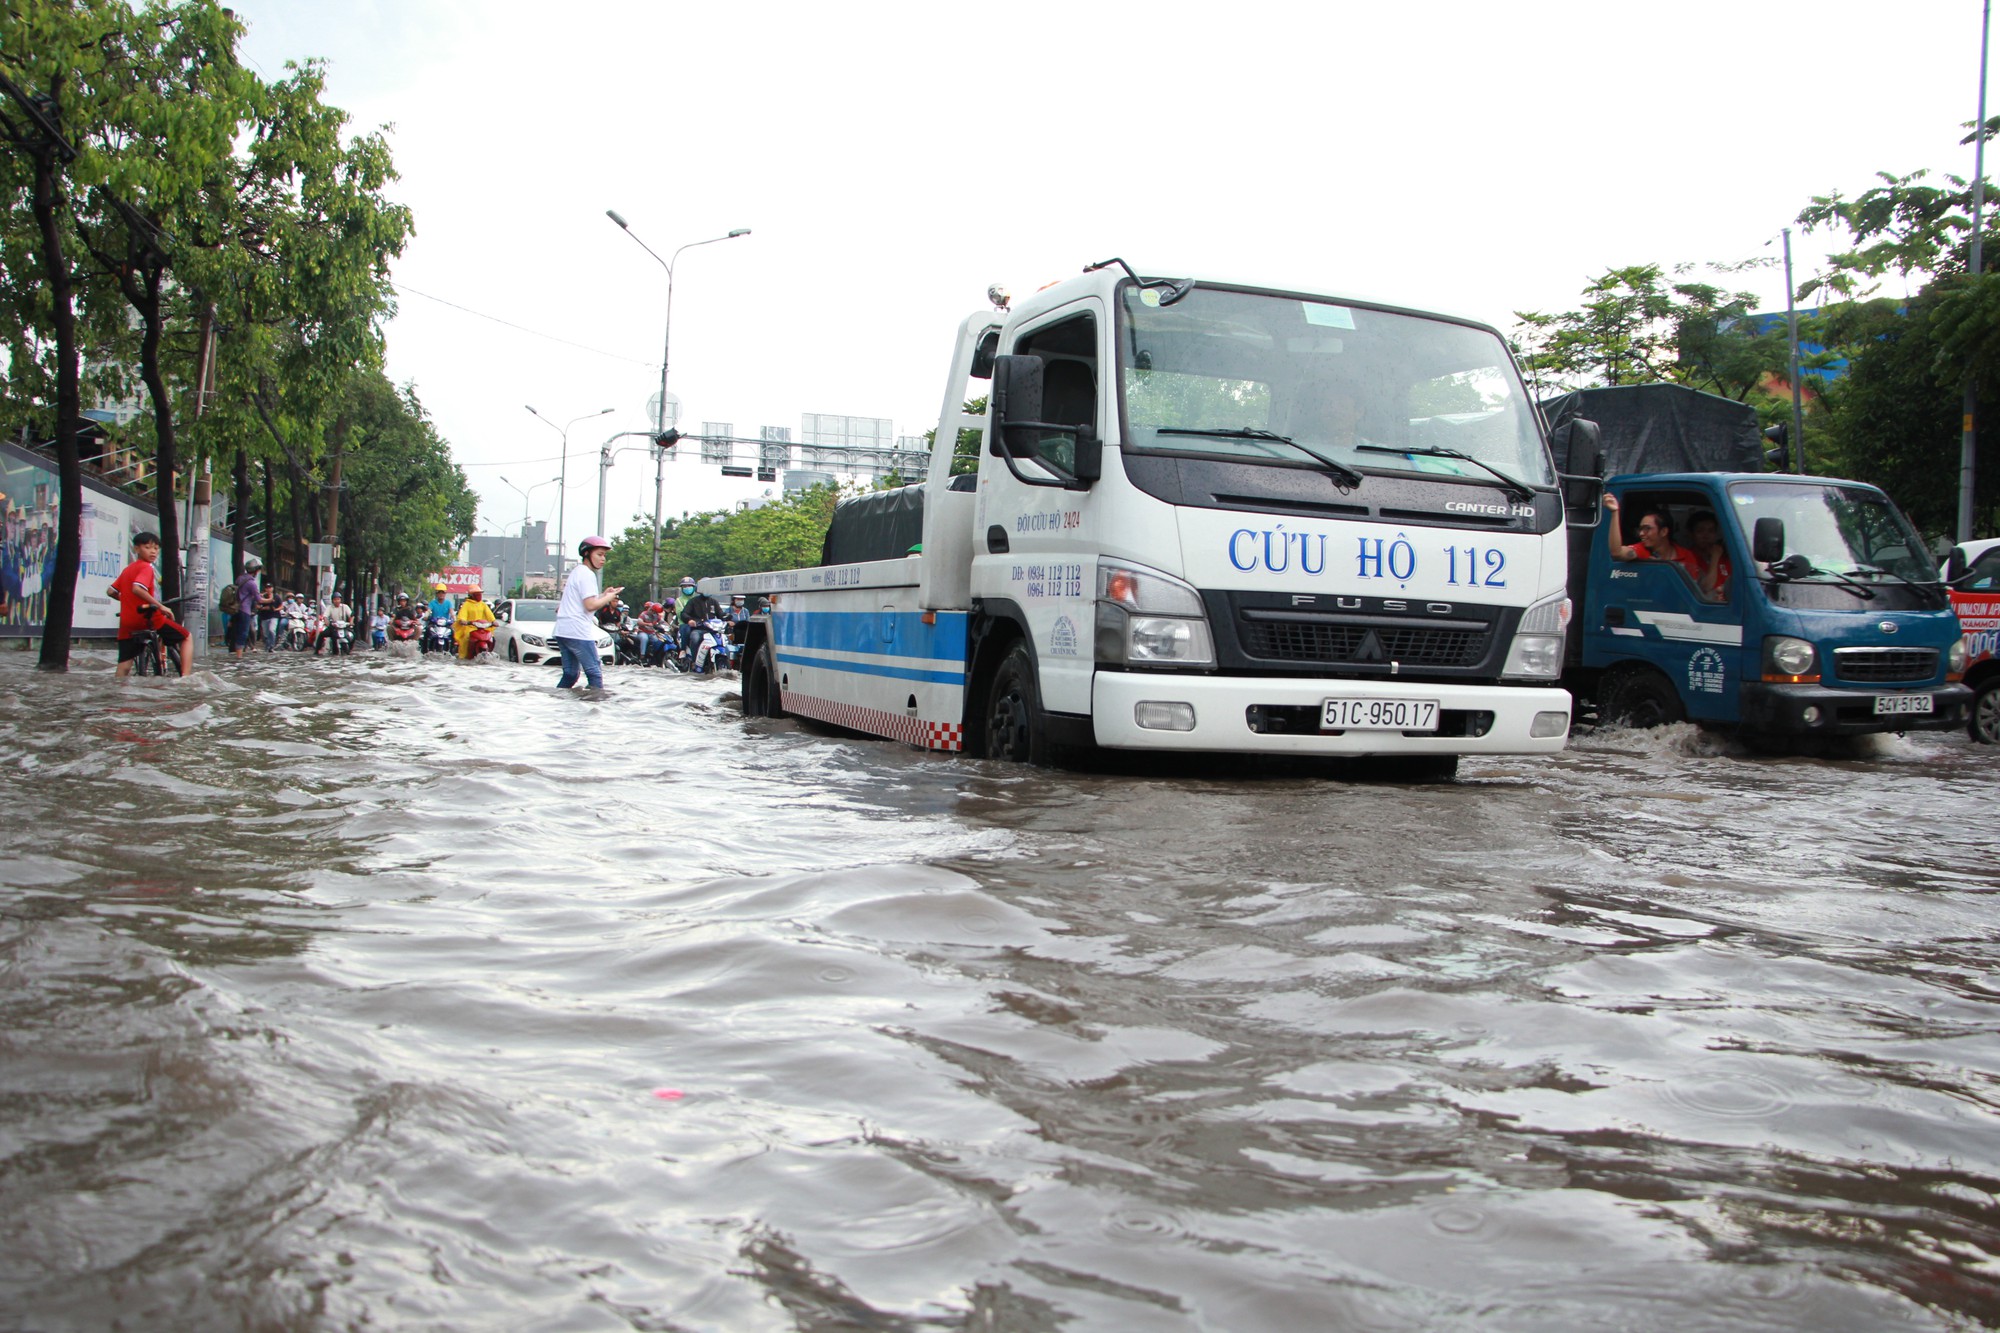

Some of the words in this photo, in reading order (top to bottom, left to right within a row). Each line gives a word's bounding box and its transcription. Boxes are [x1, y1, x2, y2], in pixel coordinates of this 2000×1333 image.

[1445, 501, 1507, 515] CANTER
[1511, 505, 1535, 518] HD
[1049, 509, 1061, 532] HỘ
[1063, 511, 1080, 530] 24/24
[1228, 524, 1327, 576] CỨU
[1355, 532, 1417, 589] HỘ
[1443, 545, 1507, 589] 112
[789, 572, 798, 588] 112
[824, 570, 836, 587] 0934
[838, 568, 848, 586] 112
[850, 567, 861, 585] 112
[1028, 565, 1045, 580] 0934
[1048, 565, 1063, 580] 112
[1066, 565, 1081, 580] 112
[1027, 582, 1044, 597] 0964
[1048, 581, 1062, 596] 112
[1065, 581, 1081, 596] 112
[1291, 595, 1453, 615] FUSO
[1957, 602, 1989, 616] VINASUN
[1962, 620, 1998, 628] NAMMOI
[1325, 701, 1435, 727] 51C-950.17
